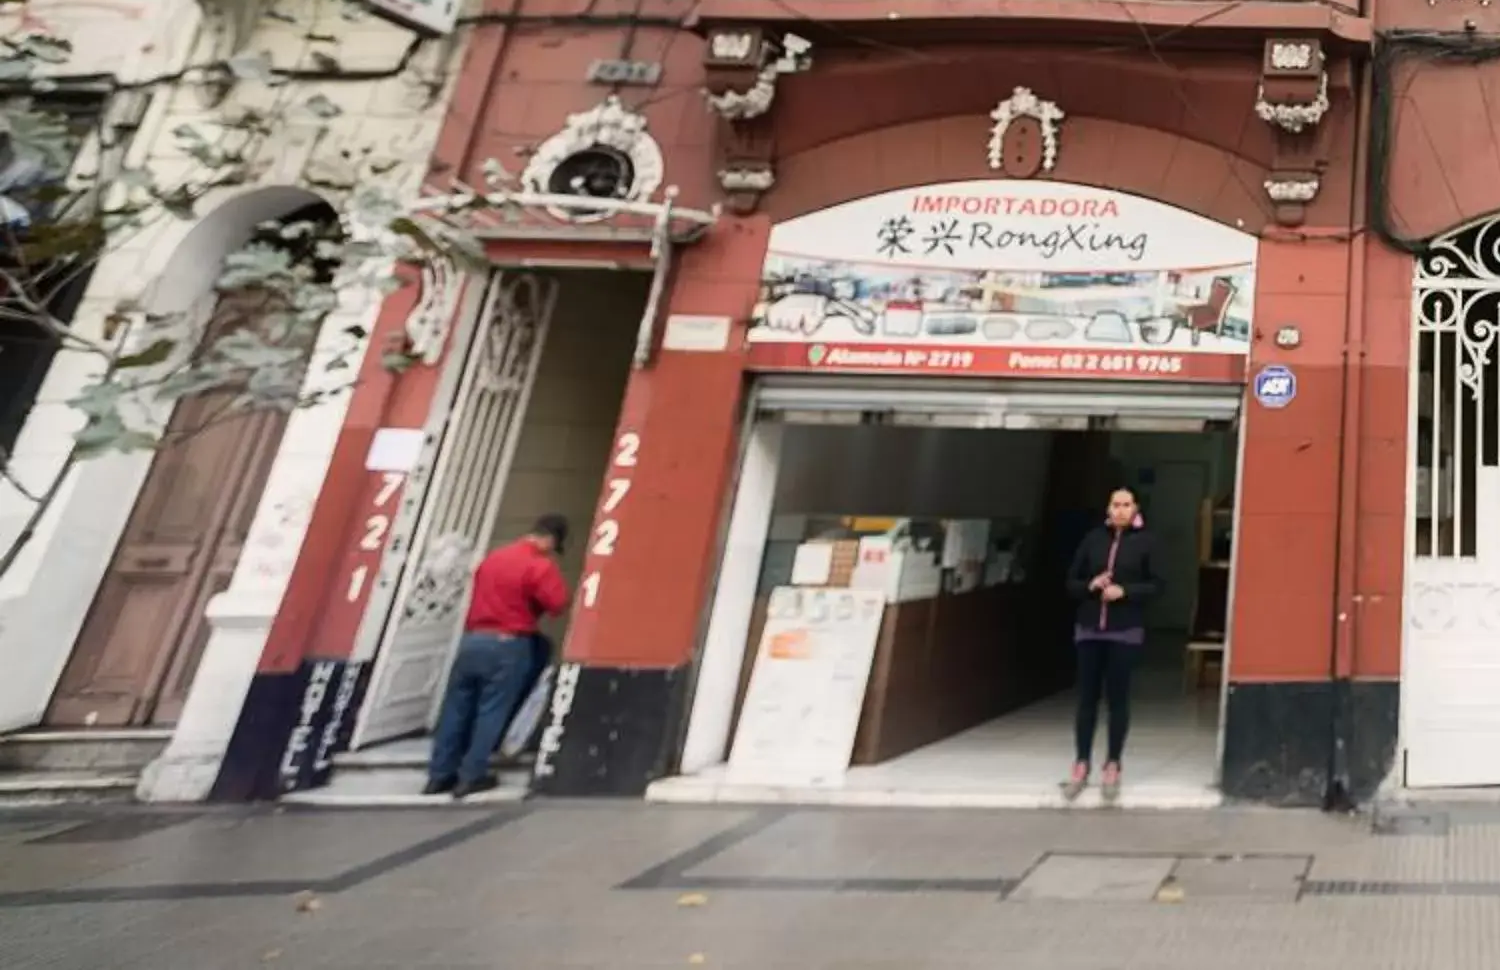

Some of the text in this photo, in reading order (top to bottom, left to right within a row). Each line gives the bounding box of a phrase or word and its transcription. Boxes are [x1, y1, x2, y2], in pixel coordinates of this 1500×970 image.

[912, 195, 1119, 218] IMPORTADORA
[968, 221, 1148, 260] RongXing
[927, 350, 974, 369] 2719
[1085, 354, 1098, 371] 2
[580, 432, 641, 608] 2721
[281, 661, 336, 775] HOTEL
[535, 662, 581, 777] HOTEL
